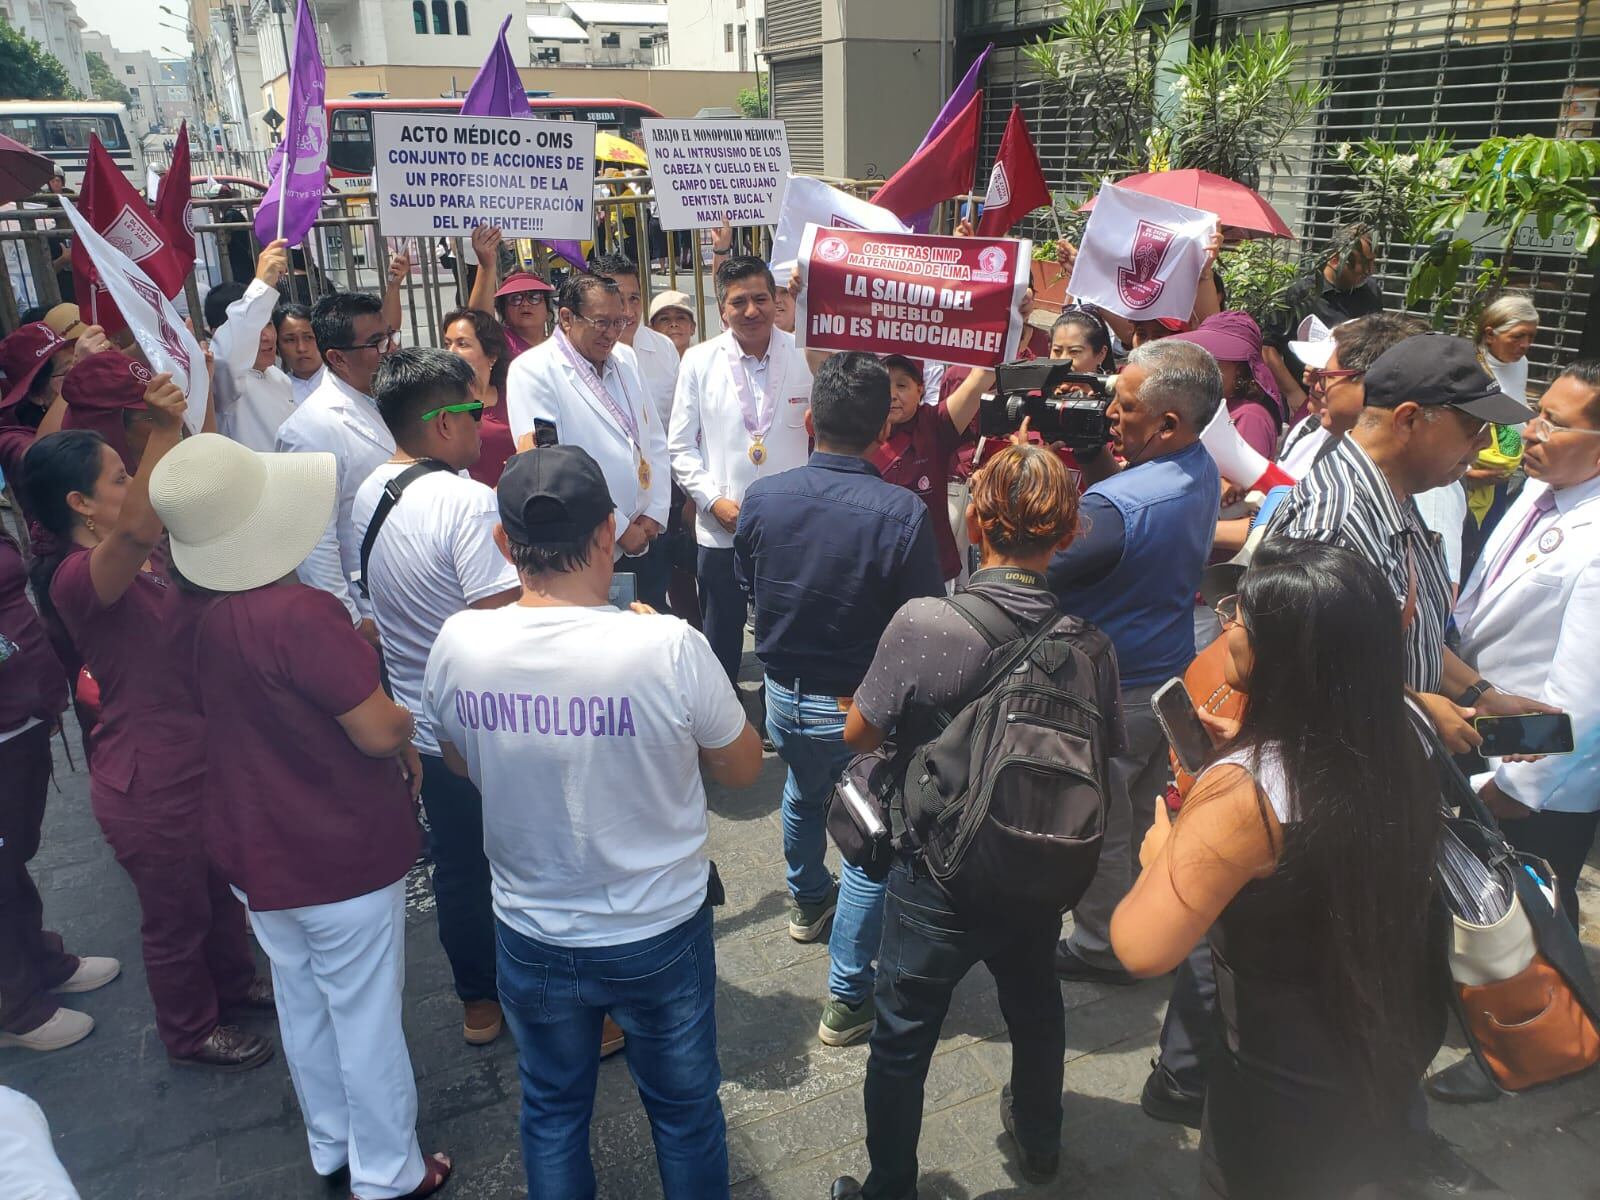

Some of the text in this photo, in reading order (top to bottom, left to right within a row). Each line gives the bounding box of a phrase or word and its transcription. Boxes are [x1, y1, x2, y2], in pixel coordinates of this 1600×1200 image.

[587, 112, 615, 121] SUBIDA
[400, 125, 448, 143] ACTO
[454, 124, 521, 146] MÉDICO
[536, 131, 573, 149] OMS
[652, 127, 783, 143] ABAJO EL MONOPOLIO MÉDICO!!!
[389, 150, 584, 171] CONJUNTO DE ACCIONES DE
[655, 146, 782, 159] NO AL INTRUSISMO DE LOS
[663, 162, 780, 175] CABEZA Y CUELLO EN EL
[406, 172, 568, 191] UN PROFESIONAL DE LA
[672, 177, 777, 191] CAMPO DEL CIRUJANO
[390, 193, 584, 212] SALUD PARA RECUPERACIÓN
[681, 192, 773, 206] DENTISTA BUCAL Y
[123, 221, 134, 233] LEY
[433, 215, 544, 231] DEL PACIENTE!!!!
[863, 242, 929, 262] OBSTETRAS
[931, 247, 962, 264] INMP
[848, 253, 921, 274] MATERNIDAD
[923, 261, 941, 277] DE
[943, 264, 971, 281] LIMA
[844, 273, 974, 312] LA SALUD DEL
[870, 302, 944, 324] PUEBLO
[812, 314, 1002, 353] ¡NO ES NEGOCIABLE!
[1005, 572, 1036, 585] Nikon
[455, 689, 636, 737] ODONTOLOGIA
